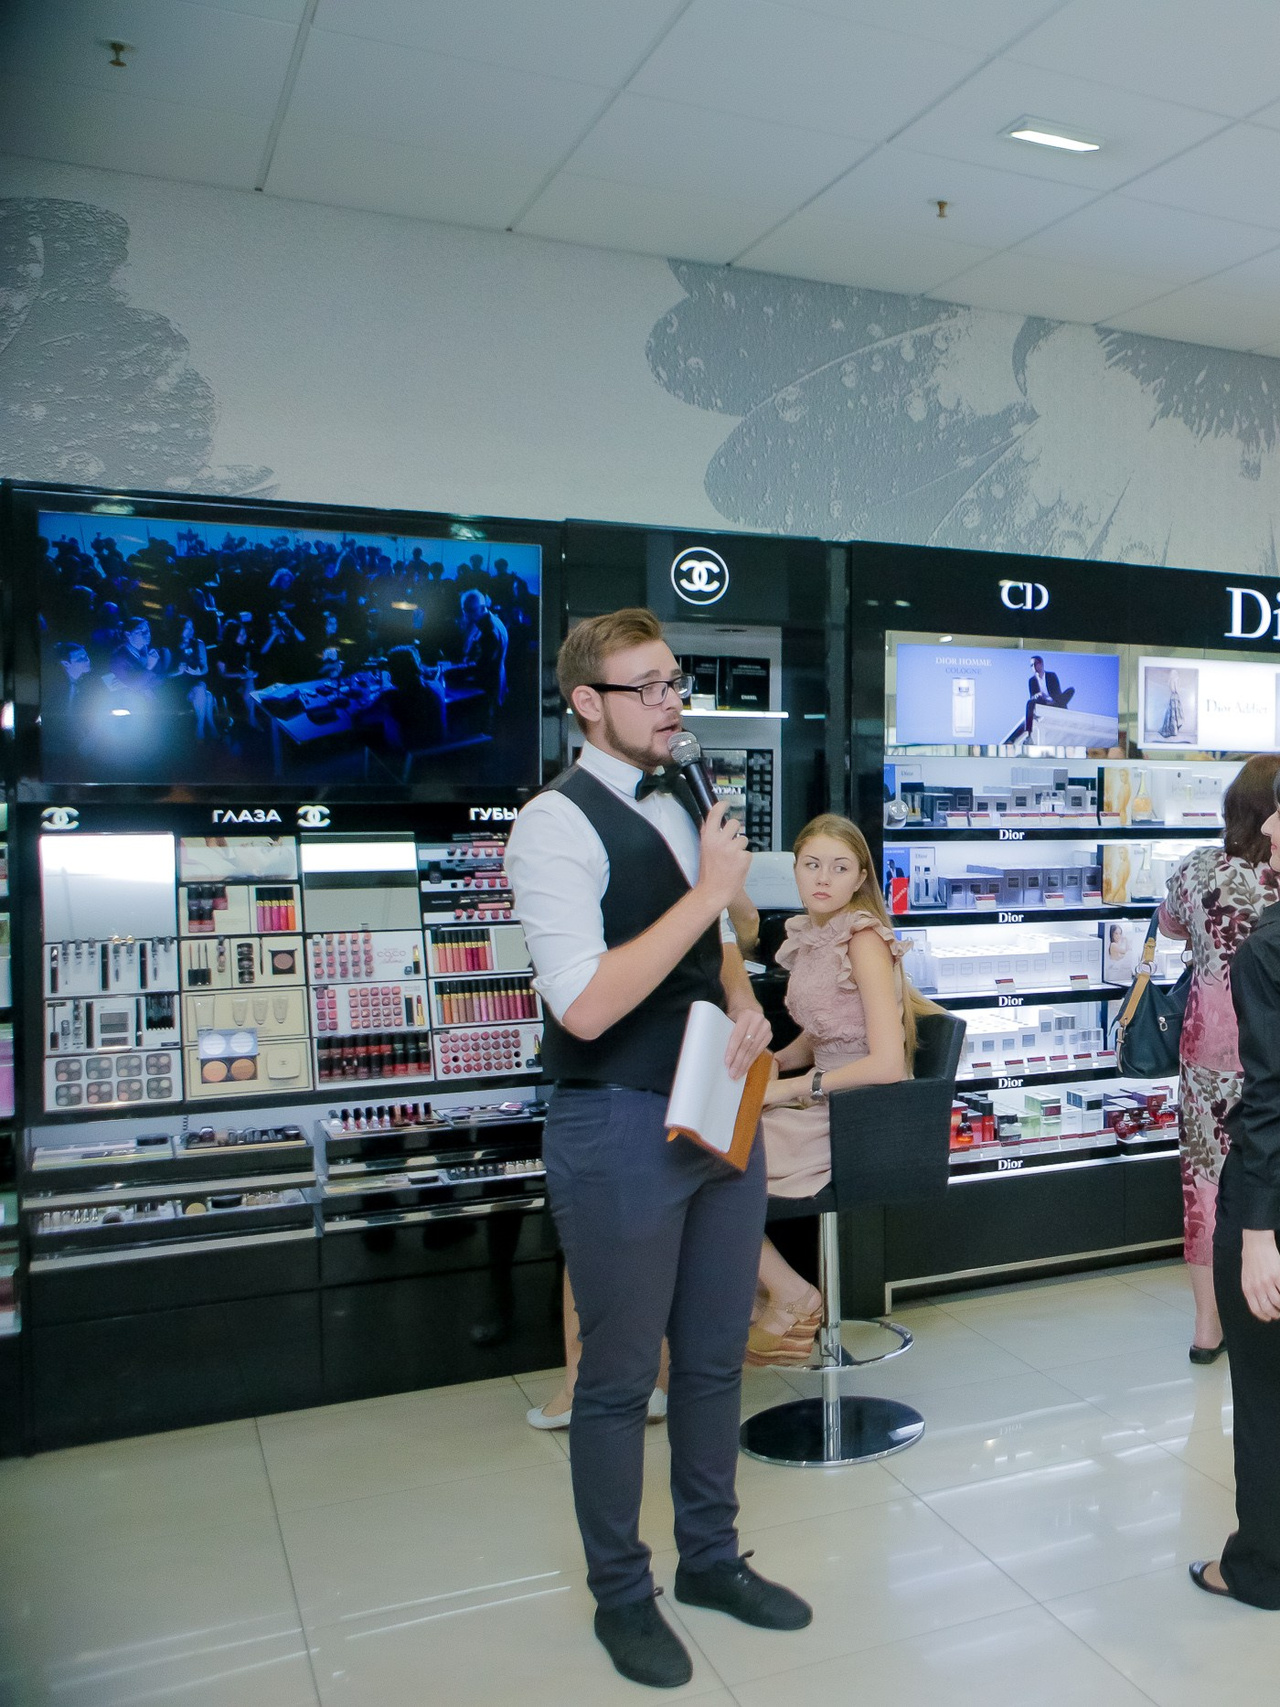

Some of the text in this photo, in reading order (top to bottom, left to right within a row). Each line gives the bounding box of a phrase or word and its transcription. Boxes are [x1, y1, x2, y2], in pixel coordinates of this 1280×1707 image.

[935, 656, 993, 667] DIOR HOMME
[945, 667, 982, 676] COLOGNE
[1206, 698, 1231, 713] Dior
[212, 809, 282, 823] ГЛАЗА
[999, 829, 1025, 841] Dior
[998, 912, 1024, 924] Dior
[998, 995, 1024, 1007] Dior
[998, 1077, 1024, 1089] Dior
[998, 1158, 1024, 1171] Dior
